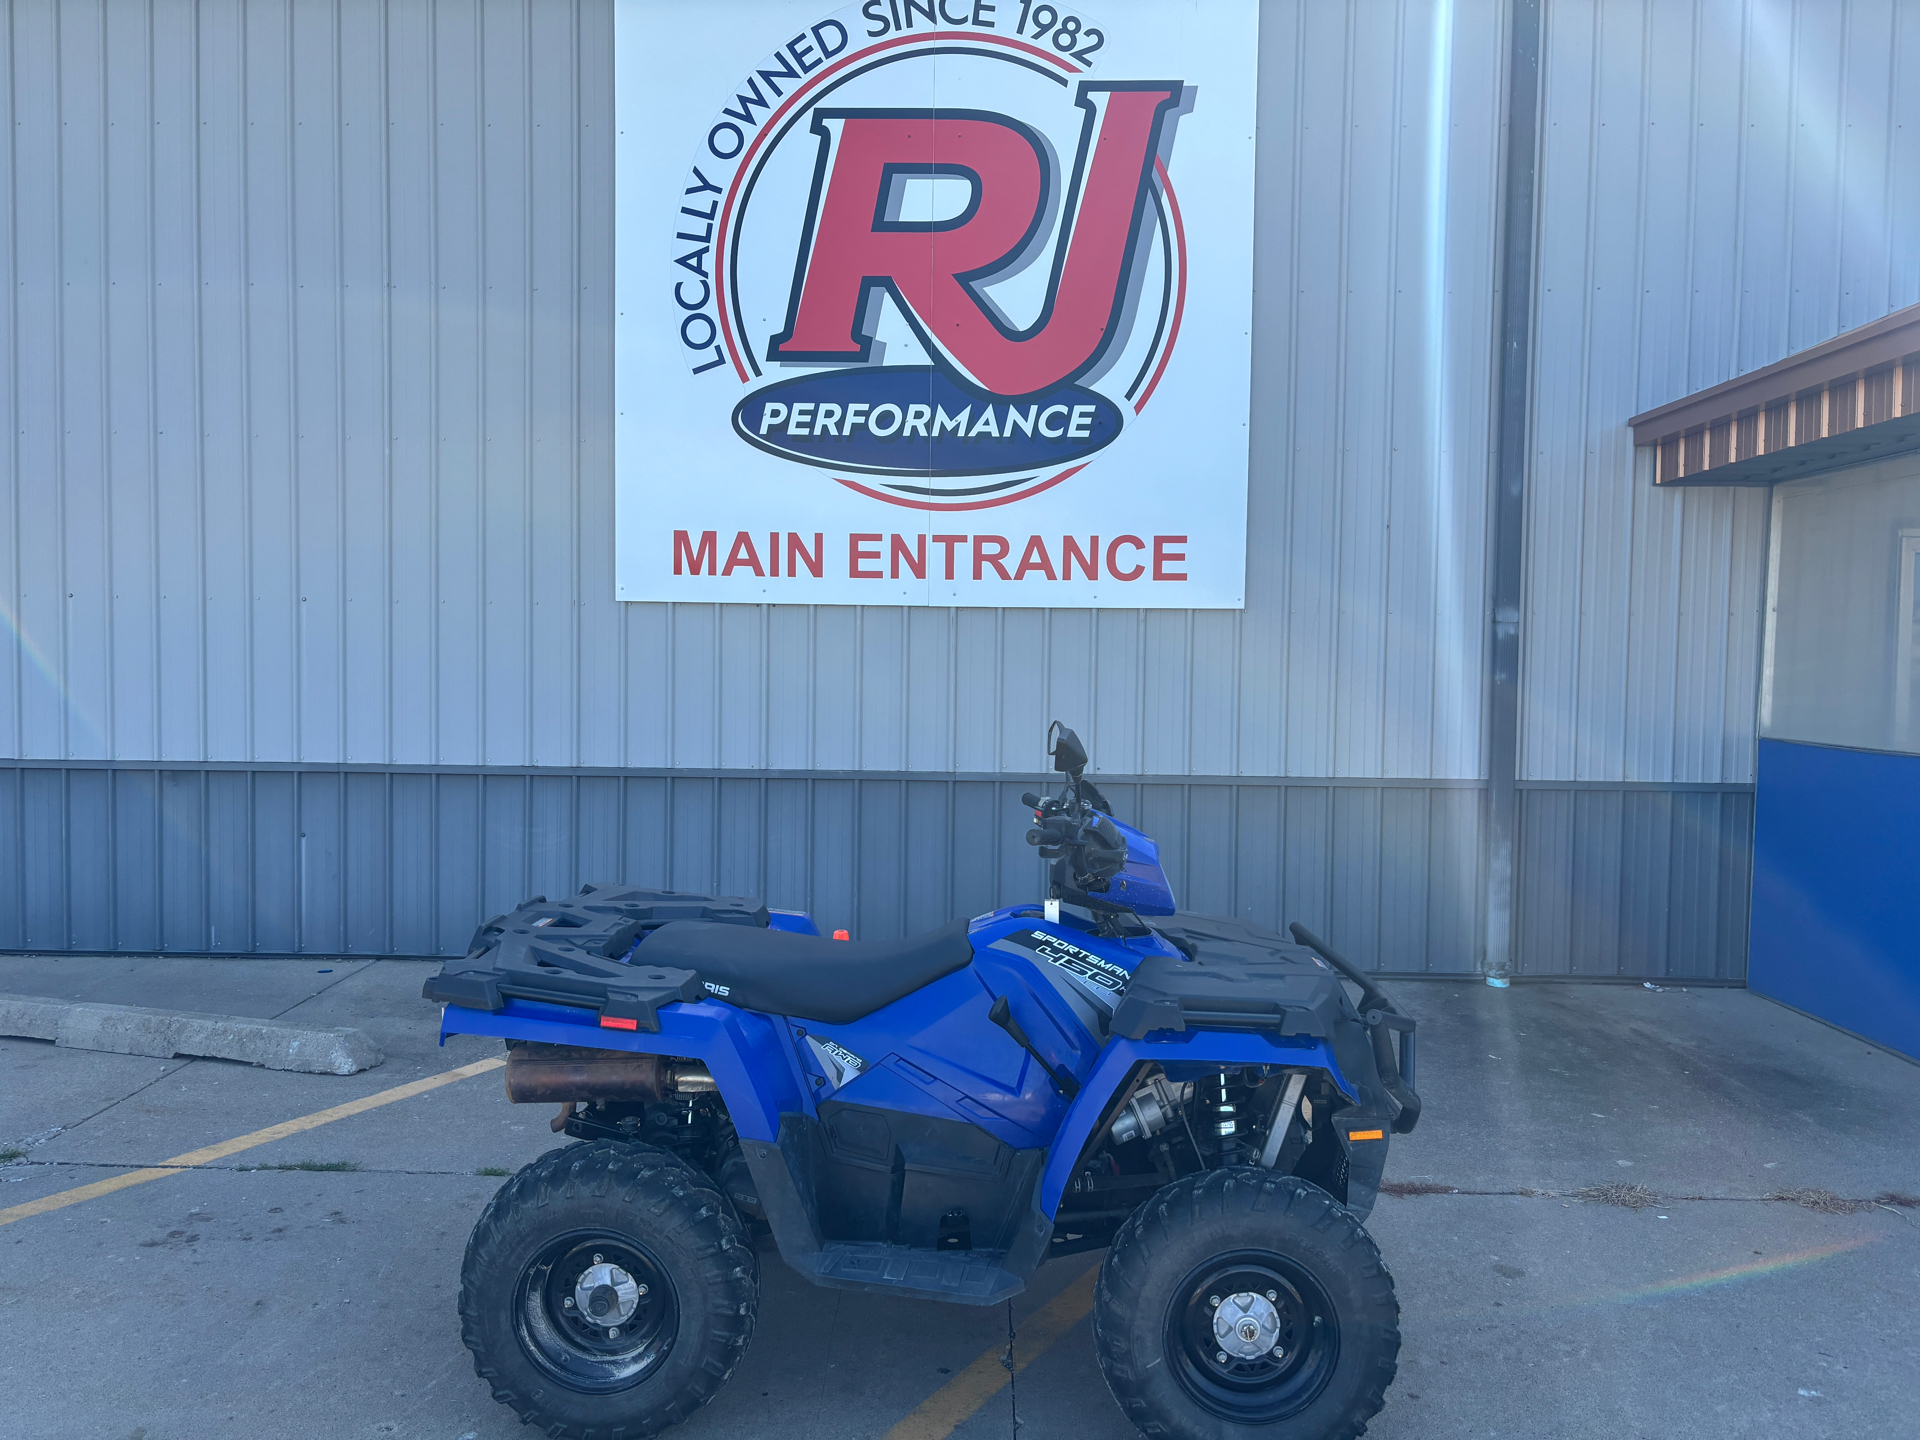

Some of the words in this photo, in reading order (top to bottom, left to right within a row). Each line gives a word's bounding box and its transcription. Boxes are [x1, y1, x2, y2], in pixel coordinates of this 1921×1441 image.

[673, 165, 727, 376] LOCALLY
[708, 19, 849, 160] OWNED
[861, 0, 996, 37] SINCE
[1015, 0, 1105, 69] 1982
[765, 80, 1184, 397] RJ
[758, 402, 1096, 439] PERFORMANCE
[672, 529, 825, 579] MAIN
[847, 532, 1189, 582] ENTRANCE
[1030, 930, 1131, 981] SPORTSMAN
[1035, 944, 1123, 991] 450
